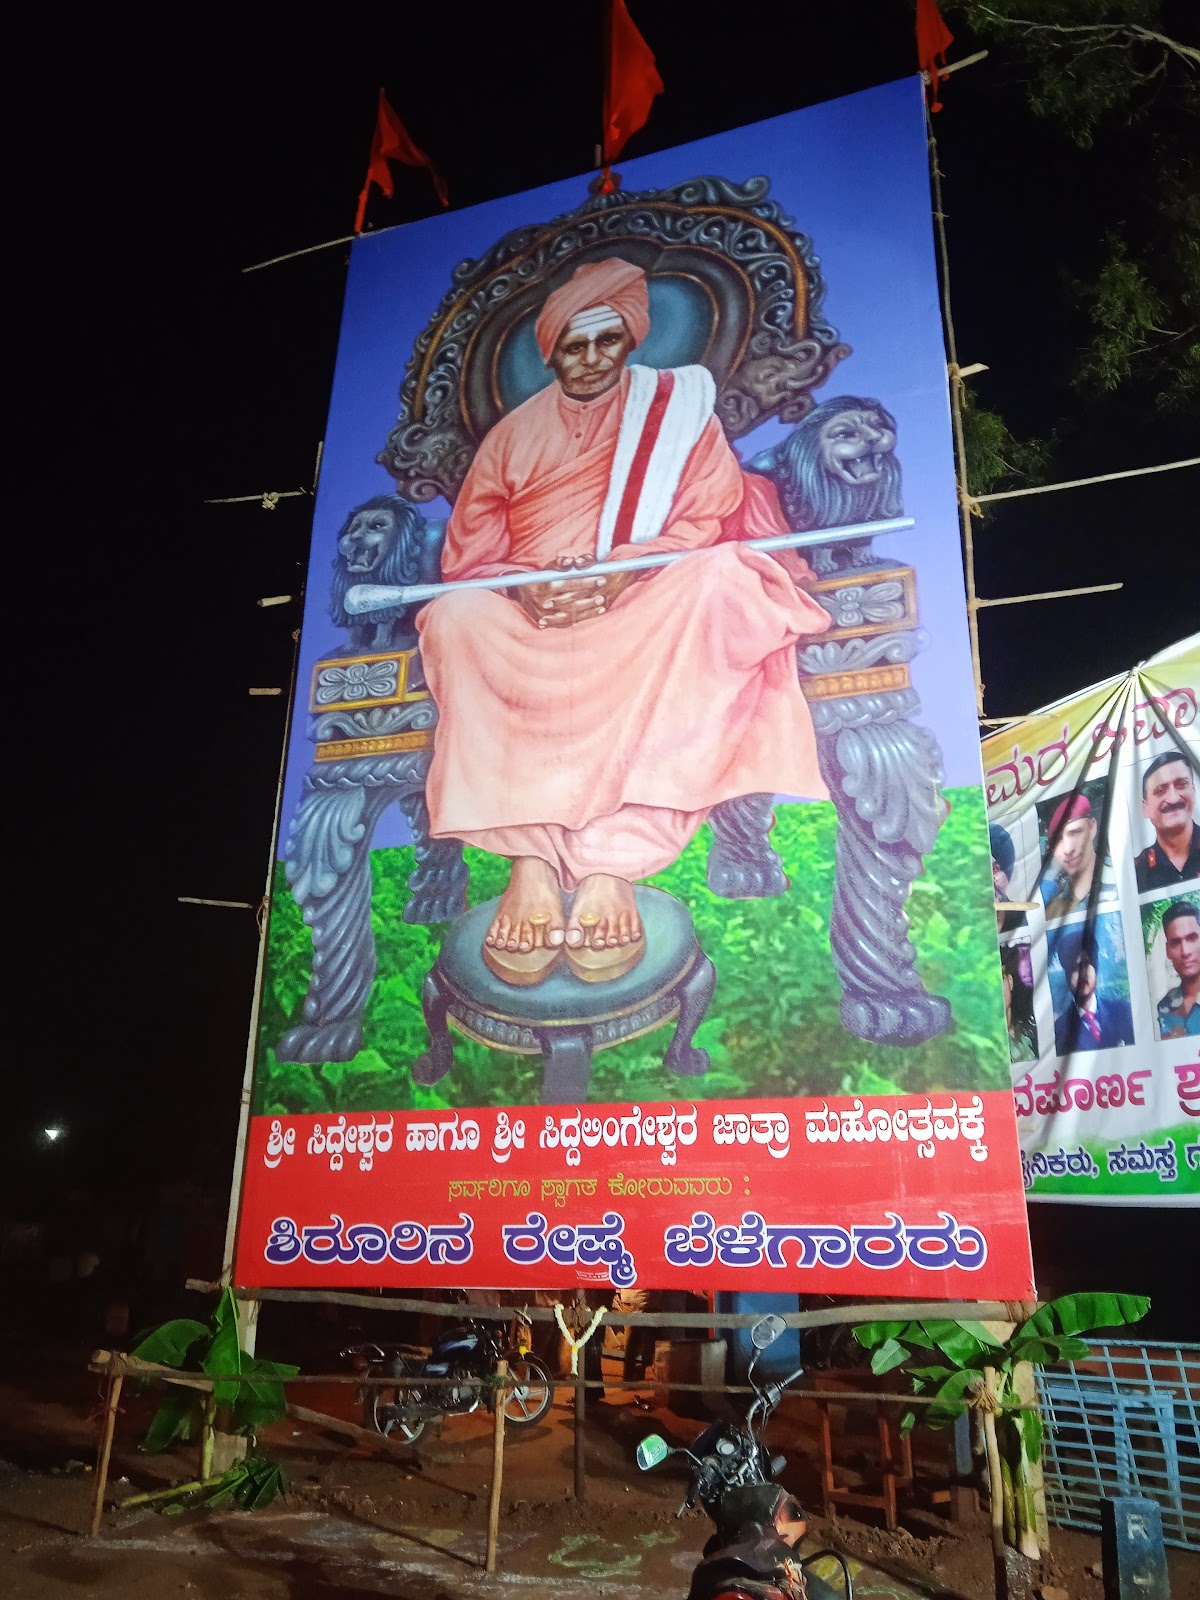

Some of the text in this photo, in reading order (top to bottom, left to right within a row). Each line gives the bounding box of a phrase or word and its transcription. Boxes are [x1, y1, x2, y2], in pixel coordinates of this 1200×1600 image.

[263, 1095, 988, 1171] ಶ್ರೀ ಸಿದ್ದೇಶ್ವರ ಹಾಗೂ ಶ್ರೀ ಸಿದ್ದಲಿಂಗೇಶ್ವರ ಜಾತ್ರಾ ಮಹೋತ್ಸವಕ್ಕೆ
[1108, 1139, 1176, 1179] ಸಮಸ್ತ
[449, 1179, 531, 1202] ಸರ್ವರಿಗೂ
[541, 1178, 598, 1208] ಸ್ವಾಗತ
[607, 1172, 733, 1198] ಕೋರುವವರು
[264, 1211, 987, 1289] ಶಿರೂರಿನ ರೇಷ್ಮೆ ಬೆಳೆಗಾರರು
